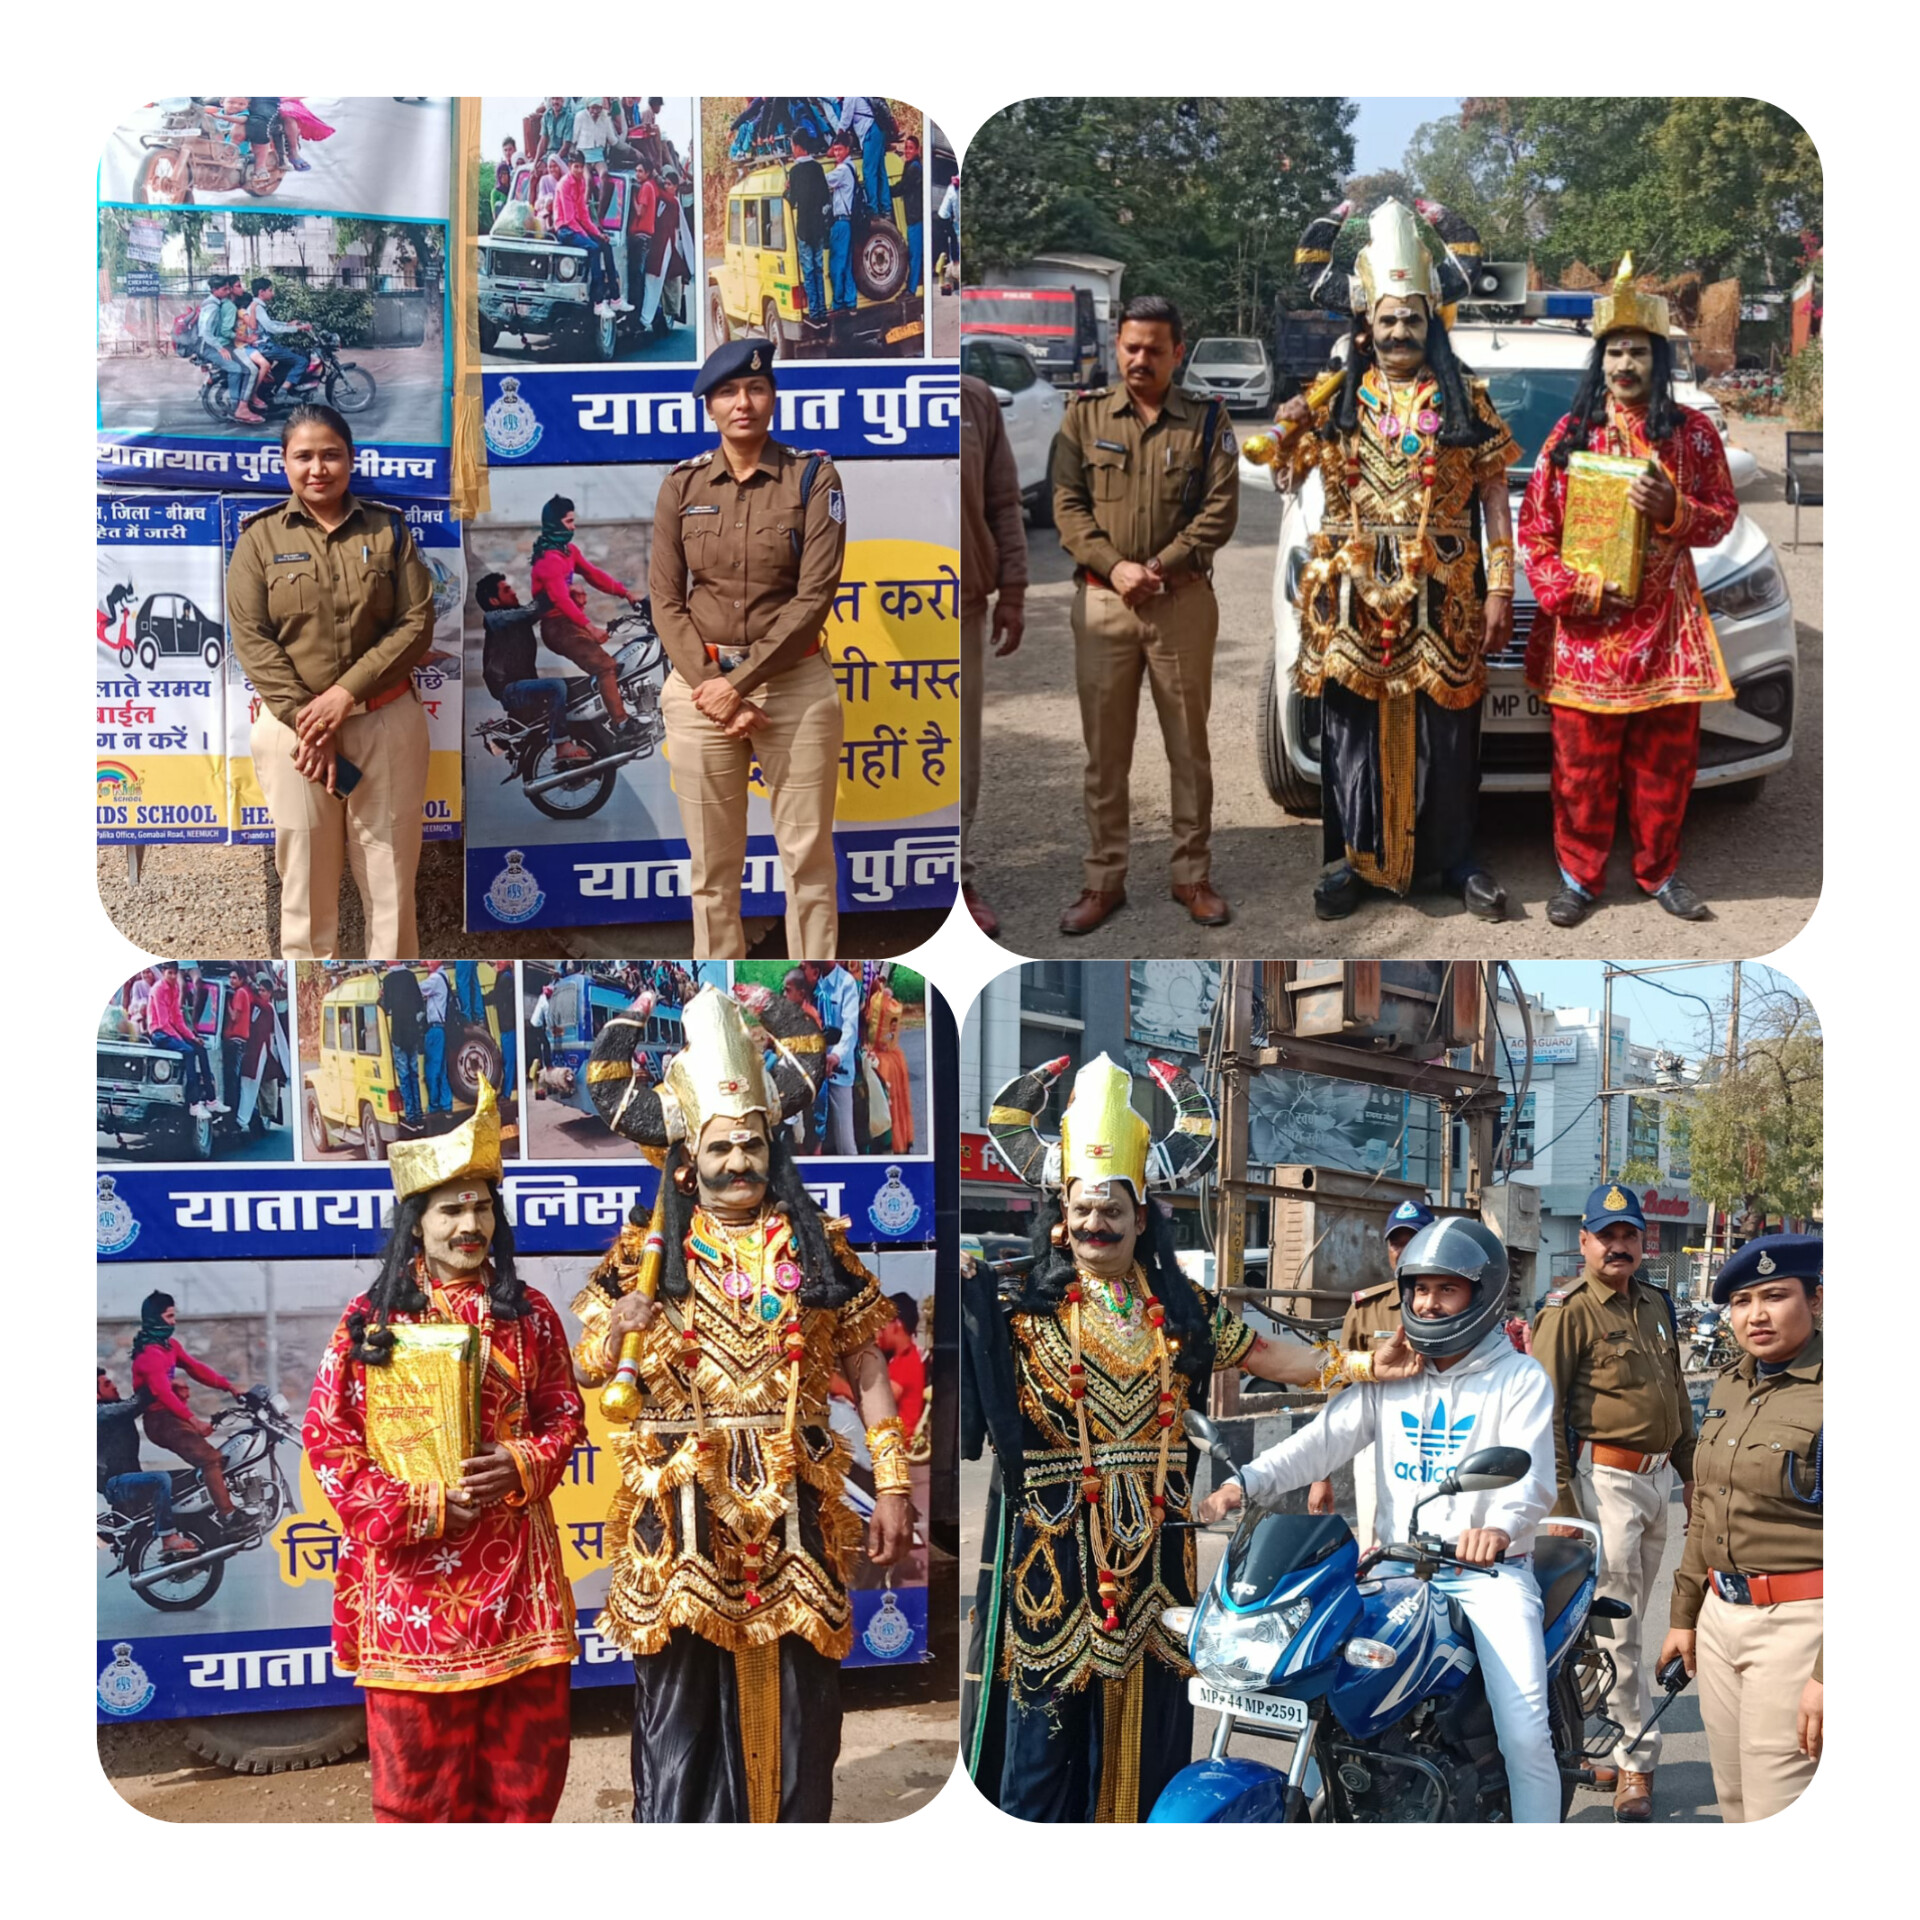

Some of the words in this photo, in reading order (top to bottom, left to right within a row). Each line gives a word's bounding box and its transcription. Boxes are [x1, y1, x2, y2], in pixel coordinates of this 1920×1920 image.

[572, 389, 845, 435] याताात
[97, 443, 231, 472] यातायात
[350, 449, 436, 479] नीमच
[111, 503, 151, 521] जिला
[166, 502, 206, 521] नीमच
[405, 505, 443, 523] नीमच
[125, 524, 140, 539] में
[144, 525, 187, 540] जारी
[147, 680, 212, 698] समय
[1492, 694, 1520, 717] MP
[123, 732, 142, 750] न
[147, 725, 188, 750] करें
[840, 724, 908, 789] नहीं
[915, 720, 952, 787] है
[136, 805, 218, 825] SCHOOL
[187, 830, 219, 838] NEEMUCH
[1511, 1037, 1573, 1048] AQAGUARD
[168, 1189, 395, 1232] याताया
[497, 1175, 641, 1227] लिस
[1641, 1189, 1690, 1217] Bata
[1231, 1581, 1258, 1596] TVS
[1386, 1596, 1420, 1625] TVS
[1227, 1694, 1243, 1710] 44
[1271, 1702, 1303, 1723] 2591
